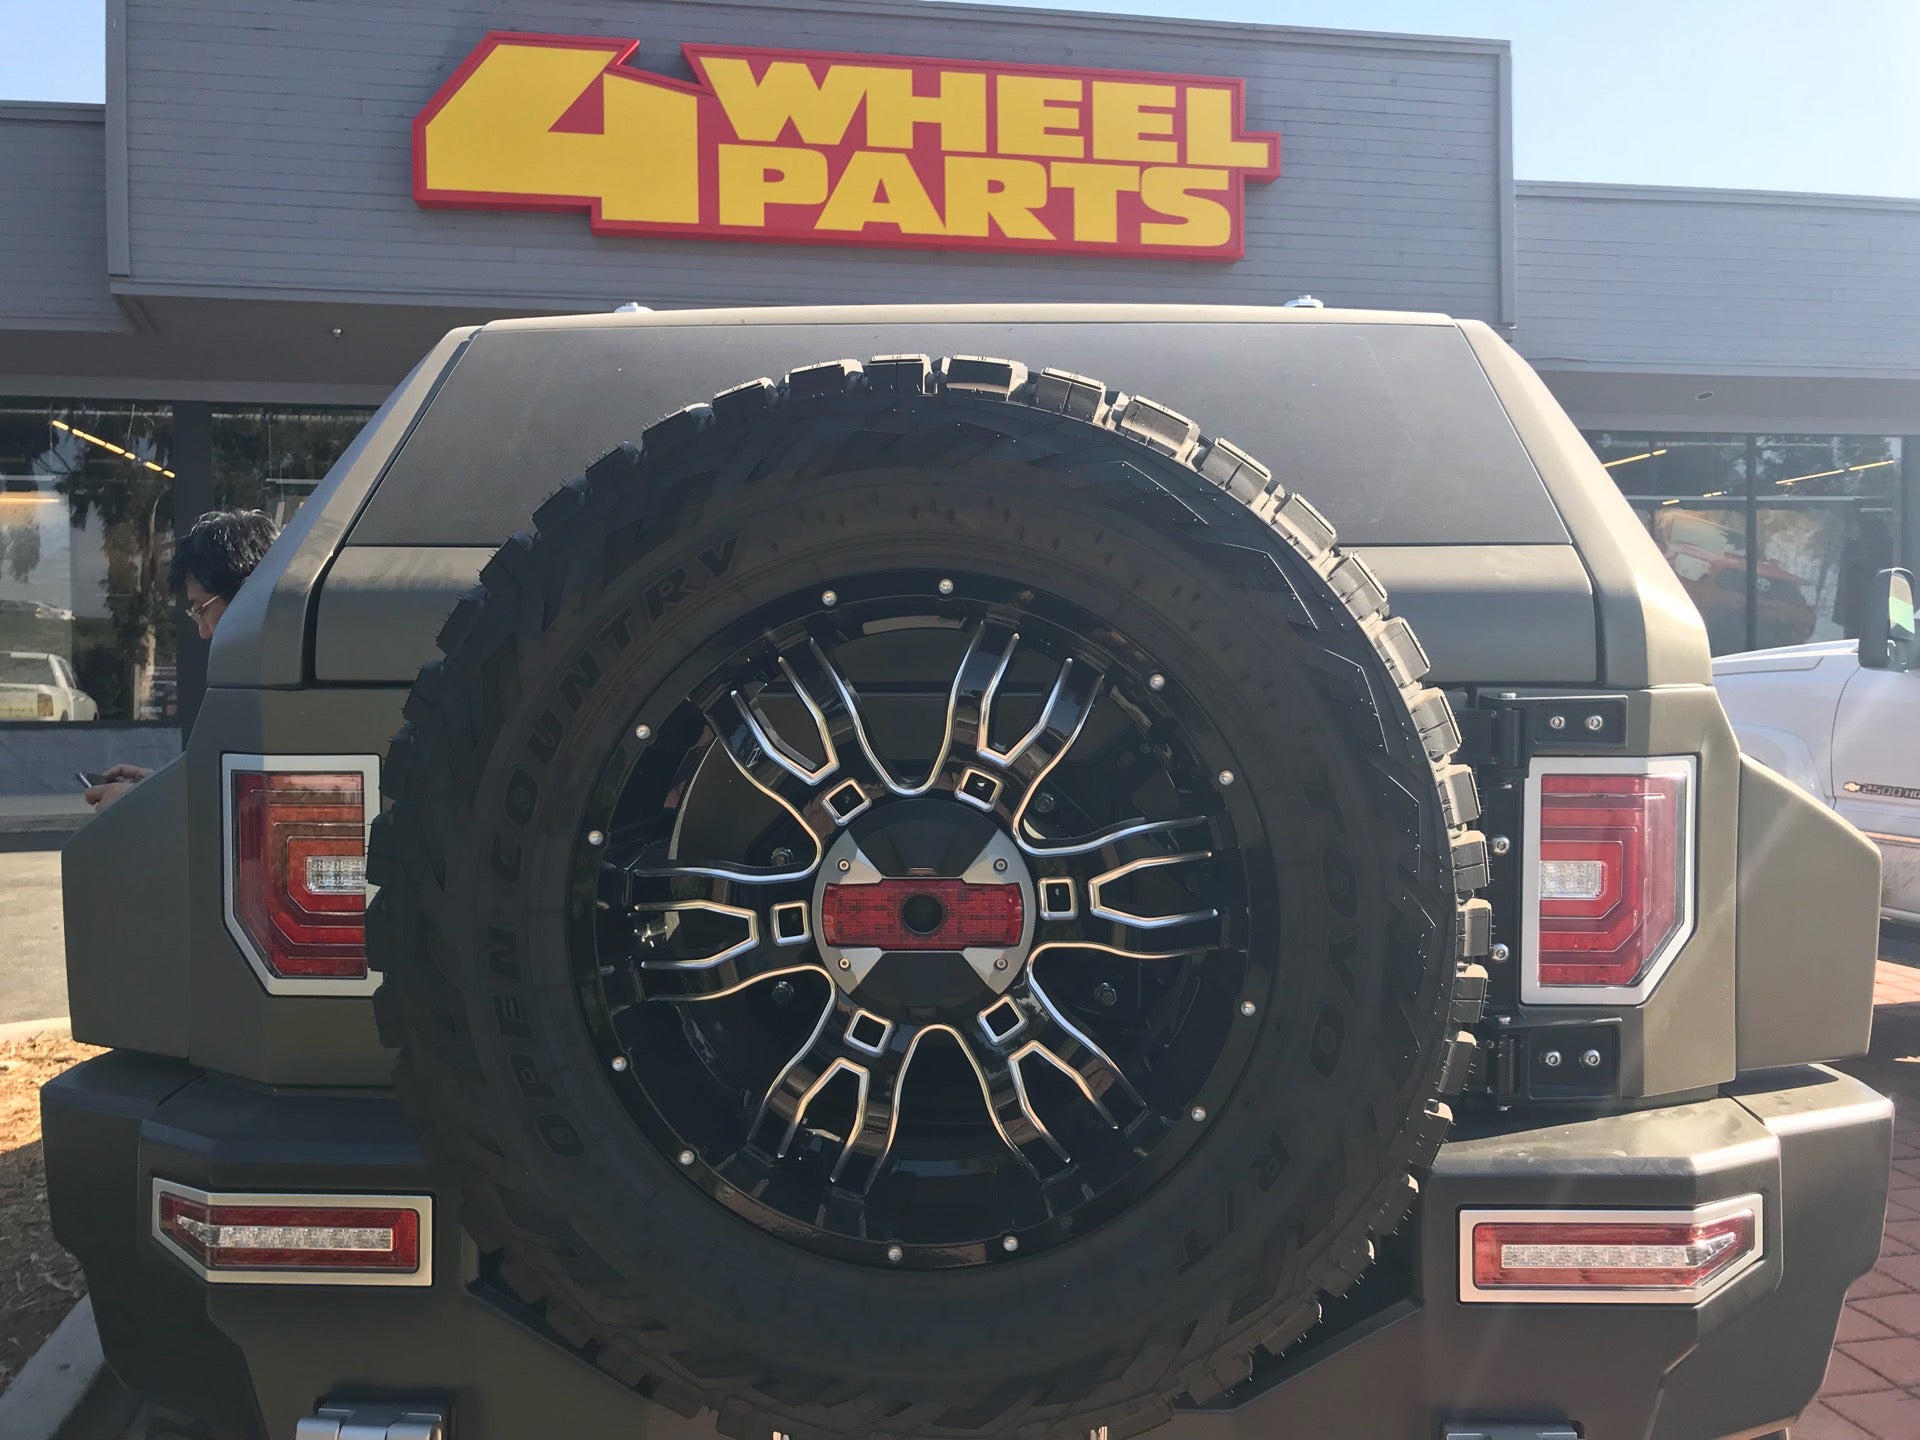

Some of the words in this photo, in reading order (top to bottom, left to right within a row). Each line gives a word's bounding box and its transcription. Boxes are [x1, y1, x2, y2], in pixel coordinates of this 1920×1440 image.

[425, 44, 699, 224] 4
[699, 56, 1268, 168] WHEEL
[717, 143, 1232, 247] PARTS
[491, 535, 739, 883] COUNTRY
[1862, 784, 1902, 797] 2500
[1302, 772, 1358, 1078] TOYO
[487, 925, 585, 1158] OPEN
